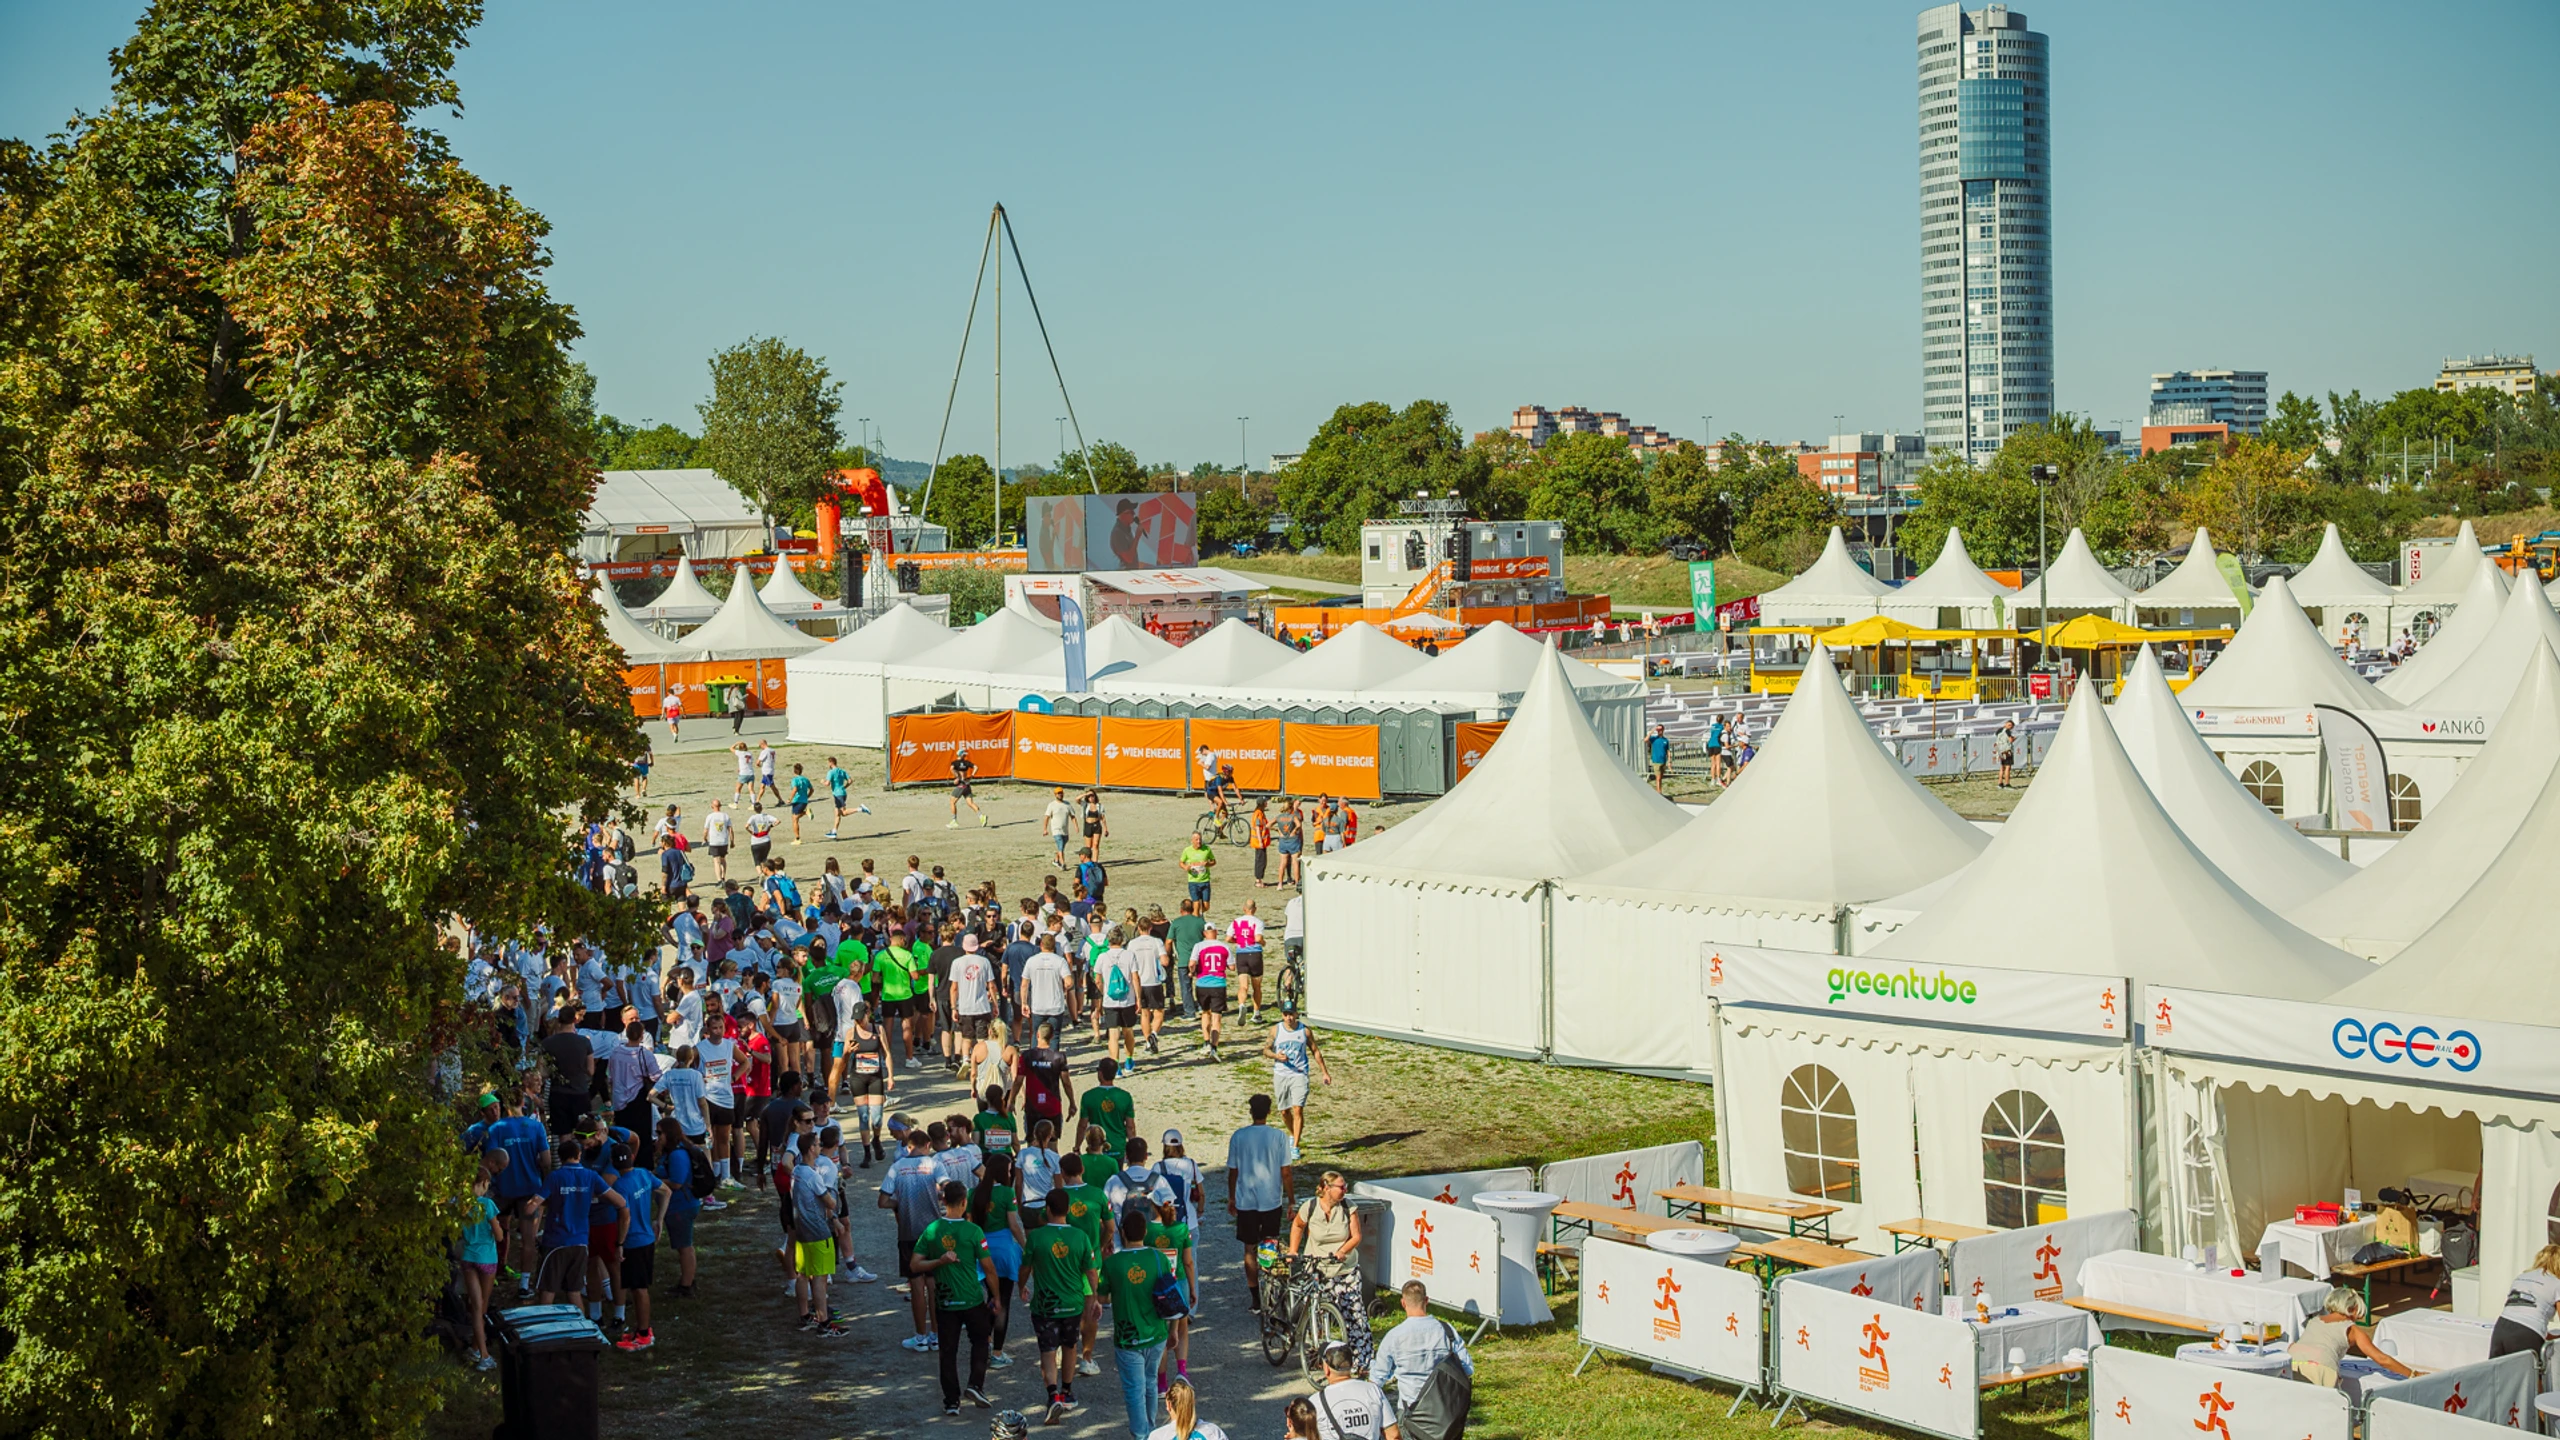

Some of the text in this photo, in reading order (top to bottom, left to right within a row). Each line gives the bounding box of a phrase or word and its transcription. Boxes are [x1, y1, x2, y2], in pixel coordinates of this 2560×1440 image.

[2246, 716, 2285, 725] GENERALI
[922, 738, 1010, 753] WIEN ENERGIE
[1035, 742, 1093, 756] WIEN ENERGIE
[1121, 746, 1182, 759] WIEN ENERGIE
[1214, 748, 1277, 760] WIEN ENERGIE
[1309, 754, 1375, 768] WIEN ENERGIE
[1204, 953, 1222, 972] T
[1827, 967, 1977, 1005] greentube
[2332, 1018, 2482, 1072] ecco
[2435, 1044, 2452, 1054] RAIL
[1653, 1327, 1681, 1340] BUSINESS
[1859, 1376, 1889, 1391] BUSINESS
[1859, 1384, 1873, 1393] RUN
[1343, 1407, 1363, 1415] TAXI
[1345, 1414, 1370, 1429] 300
